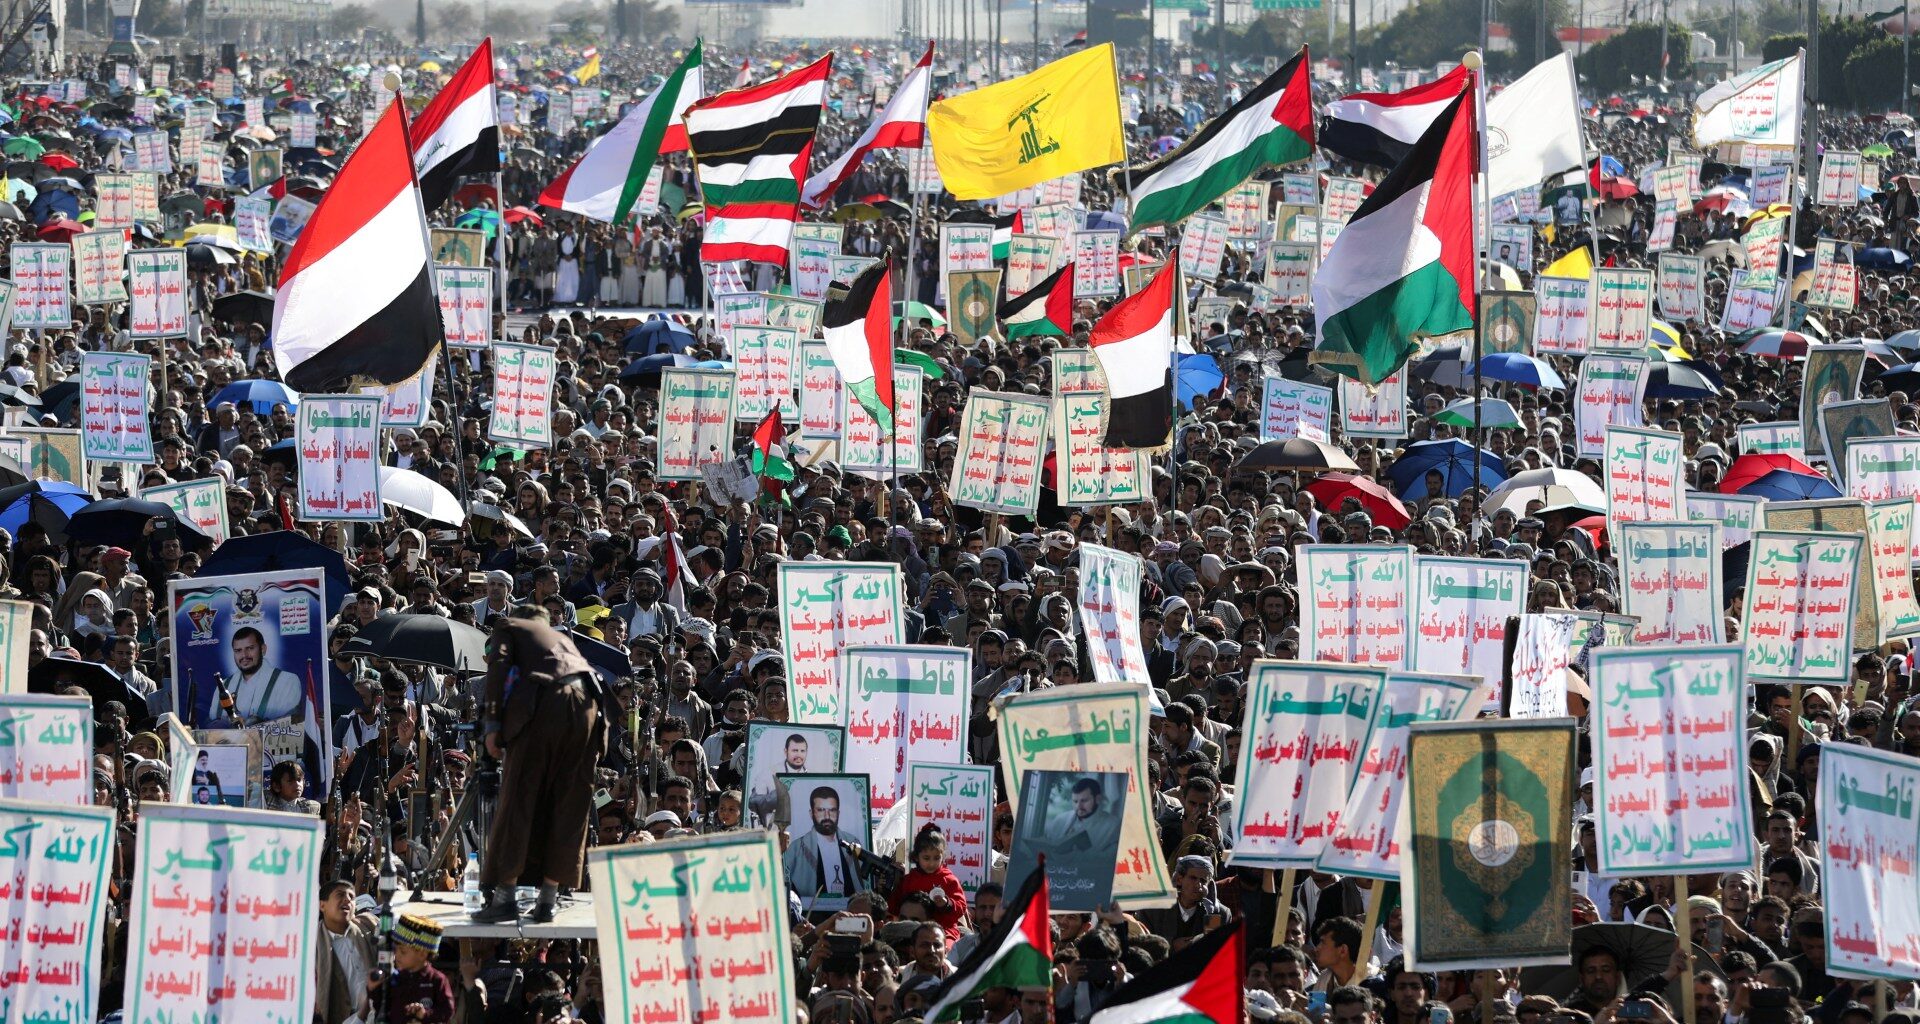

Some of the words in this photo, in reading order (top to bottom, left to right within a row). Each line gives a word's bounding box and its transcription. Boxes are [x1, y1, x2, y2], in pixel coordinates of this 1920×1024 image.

[133, 255, 179, 277] قاطعوا
[739, 333, 771, 351] أكبر
[85, 361, 122, 379] أكبر
[123, 362, 144, 379] الله
[1586, 363, 1637, 383] قاطعوا
[120, 385, 142, 398] الموت
[667, 379, 730, 400] قاطعوا
[121, 404, 143, 416] الموت
[307, 402, 371, 433] قاطعوا
[974, 405, 1017, 428] أكبر
[1017, 409, 1042, 428] الله
[344, 439, 374, 461] البضائع
[1008, 432, 1038, 447] الموت
[1611, 439, 1651, 462] أكبر
[1006, 451, 1036, 467] الموت
[1071, 458, 1095, 475] اليهود
[1114, 458, 1136, 473] اللعنة
[1652, 444, 1676, 465] الله
[1856, 447, 1920, 479] اطعوا
[336, 464, 342, 483] و
[965, 466, 991, 482] اليهود
[993, 470, 1008, 485] على
[1010, 470, 1033, 486] اللعنة
[1099, 460, 1111, 476] على
[1647, 472, 1672, 488] الموت
[1000, 488, 1031, 509] النصر
[1071, 478, 1105, 500] للإسلام
[1108, 477, 1136, 496] النصر
[1647, 493, 1673, 509] الموت
[1885, 510, 1909, 530] الله
[1629, 529, 1707, 564] قاطعوا
[1759, 537, 1817, 565] أكبر
[1818, 542, 1854, 563] الله
[1883, 539, 1907, 557] الموت
[1315, 554, 1368, 591] أكبر
[1371, 556, 1403, 582] الله
[1673, 570, 1707, 592] البضائع
[1810, 571, 1848, 589] الموت
[789, 571, 847, 613] أكبر
[852, 574, 890, 603] الله
[1427, 566, 1513, 605] قاطعوا
[1366, 591, 1403, 612] الموت
[1668, 595, 1674, 614] و
[1807, 597, 1846, 615] الموت
[848, 608, 891, 630] الموت
[1366, 618, 1404, 639] الموت
[1749, 620, 1786, 639] اليهود
[1814, 622, 1843, 640] اللعنة
[1790, 623, 1809, 642] على
[1376, 645, 1404, 662] اللعنة
[1461, 644, 1469, 668] و
[1748, 642, 1795, 674] للإسلام
[1801, 644, 1842, 671] النصر
[795, 667, 832, 689] اليهود
[857, 658, 955, 702] قاطعوا
[1606, 656, 1684, 711] أكبر
[1687, 663, 1733, 697] الله
[1262, 683, 1371, 723] قاطعوا
[38, 715, 88, 746] الله
[908, 708, 959, 744] البضائع
[1012, 708, 1131, 762] قاطعوا
[1680, 710, 1733, 736] الموت
[894, 745, 904, 774] و
[1309, 732, 1359, 769] البضائع
[1682, 748, 1734, 776] الموت
[30, 759, 88, 786] الموت
[915, 771, 958, 801] أكبر
[960, 776, 986, 797] الله
[1292, 774, 1303, 799] و
[1696, 785, 1736, 810] اللعنة
[1835, 761, 1915, 820] قاطعوا
[1379, 786, 1390, 812] و
[1608, 788, 1657, 818] اليهود
[1664, 787, 1689, 816] على
[955, 808, 984, 823] الموت
[45, 826, 98, 864] الله
[954, 831, 984, 846] الموت
[1611, 822, 1676, 861] للإسلام
[1683, 817, 1740, 859] النصر
[152, 828, 246, 881] أكبر
[248, 839, 304, 876] الله
[961, 852, 983, 867] اللعنة
[622, 853, 706, 911] أكبر
[712, 855, 766, 894] الله
[31, 879, 92, 908] الموت
[234, 892, 301, 922] الموت
[27, 921, 85, 950] الموت
[706, 908, 770, 941] الموت
[232, 934, 298, 960] الموت
[1, 961, 30, 987] على
[35, 961, 80, 987] اللعنة
[710, 948, 774, 984] الموت
[145, 974, 201, 1002] اليهود
[206, 978, 236, 1006] على
[245, 976, 296, 1002] اللعنة
[632, 997, 685, 1024] اليهود
[692, 998, 720, 1024] على
[729, 991, 777, 1019] اللعنة
